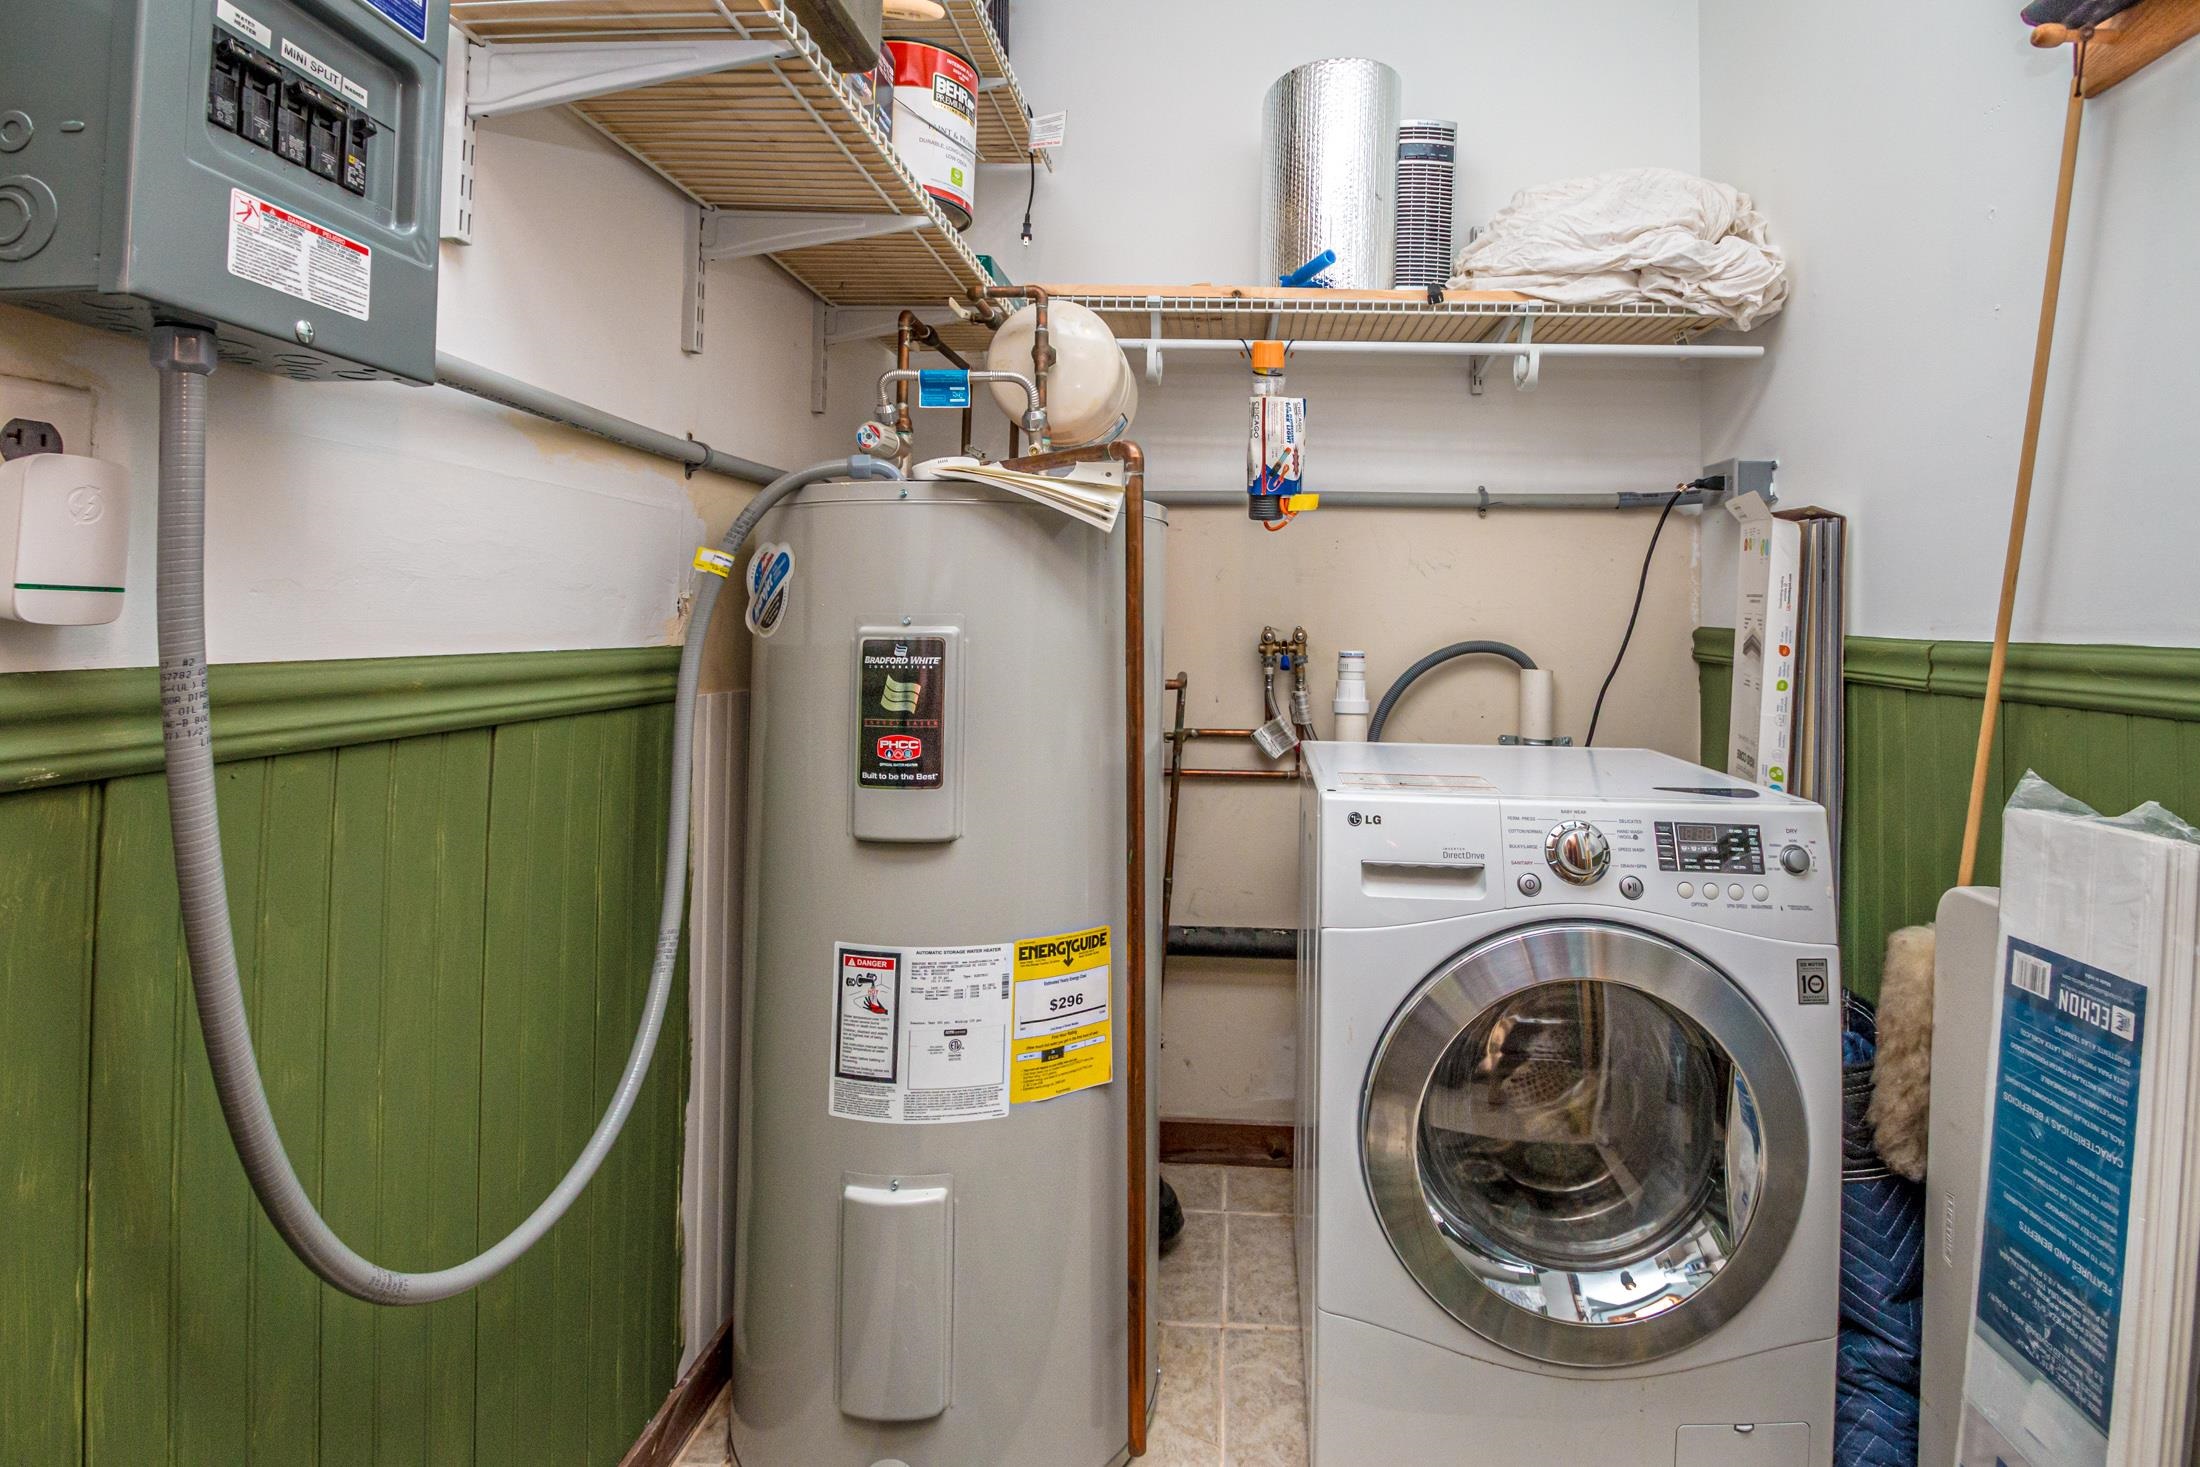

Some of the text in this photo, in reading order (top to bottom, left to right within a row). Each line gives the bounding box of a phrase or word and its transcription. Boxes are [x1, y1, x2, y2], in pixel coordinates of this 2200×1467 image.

[233, 19, 257, 37] HEATER
[284, 44, 340, 85] MINI SPLIT
[936, 76, 968, 104] BEHR
[935, 93, 965, 114] PREMIUM
[287, 215, 312, 230] DANGER
[322, 231, 345, 245] PELIGRO
[182, 658, 194, 666] #2
[864, 656, 941, 664] BRADFORD WHITE
[178, 706, 197, 716] OIL
[880, 740, 919, 749] PHCC
[1365, 815, 1382, 825] LG
[1442, 851, 1485, 860] DirectDrive
[1019, 932, 1107, 964] ENERGYGUIDE
[857, 959, 888, 968] DANGER
[1801, 975, 1824, 994] 10
[1049, 993, 1084, 1011] $296
[2057, 987, 2109, 1030] ECHON
[2002, 1090, 2123, 1171] CARACTERÍSTICAS Y BENEFICIOS
[2067, 1235, 2089, 1258] INSTALL
[2017, 1218, 2112, 1297] FEATURES AND BENEFITS
